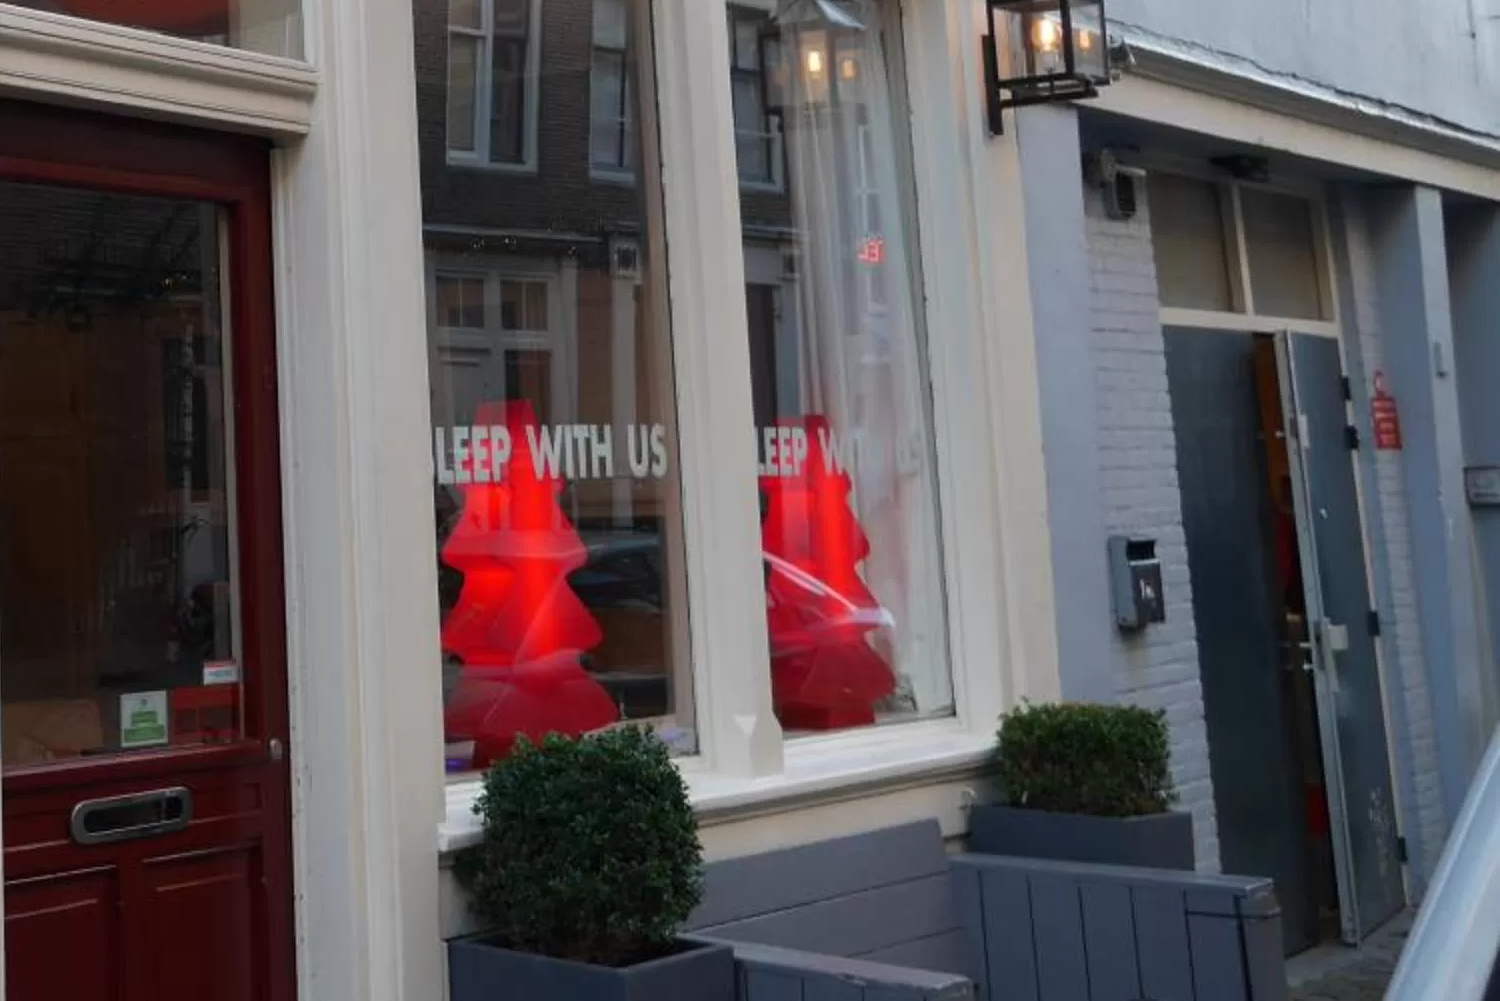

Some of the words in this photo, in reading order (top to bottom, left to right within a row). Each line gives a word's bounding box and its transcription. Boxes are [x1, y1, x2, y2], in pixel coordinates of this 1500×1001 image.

[431, 424, 512, 484] LEEP
[525, 423, 613, 480] WITH
[627, 423, 668, 478] US
